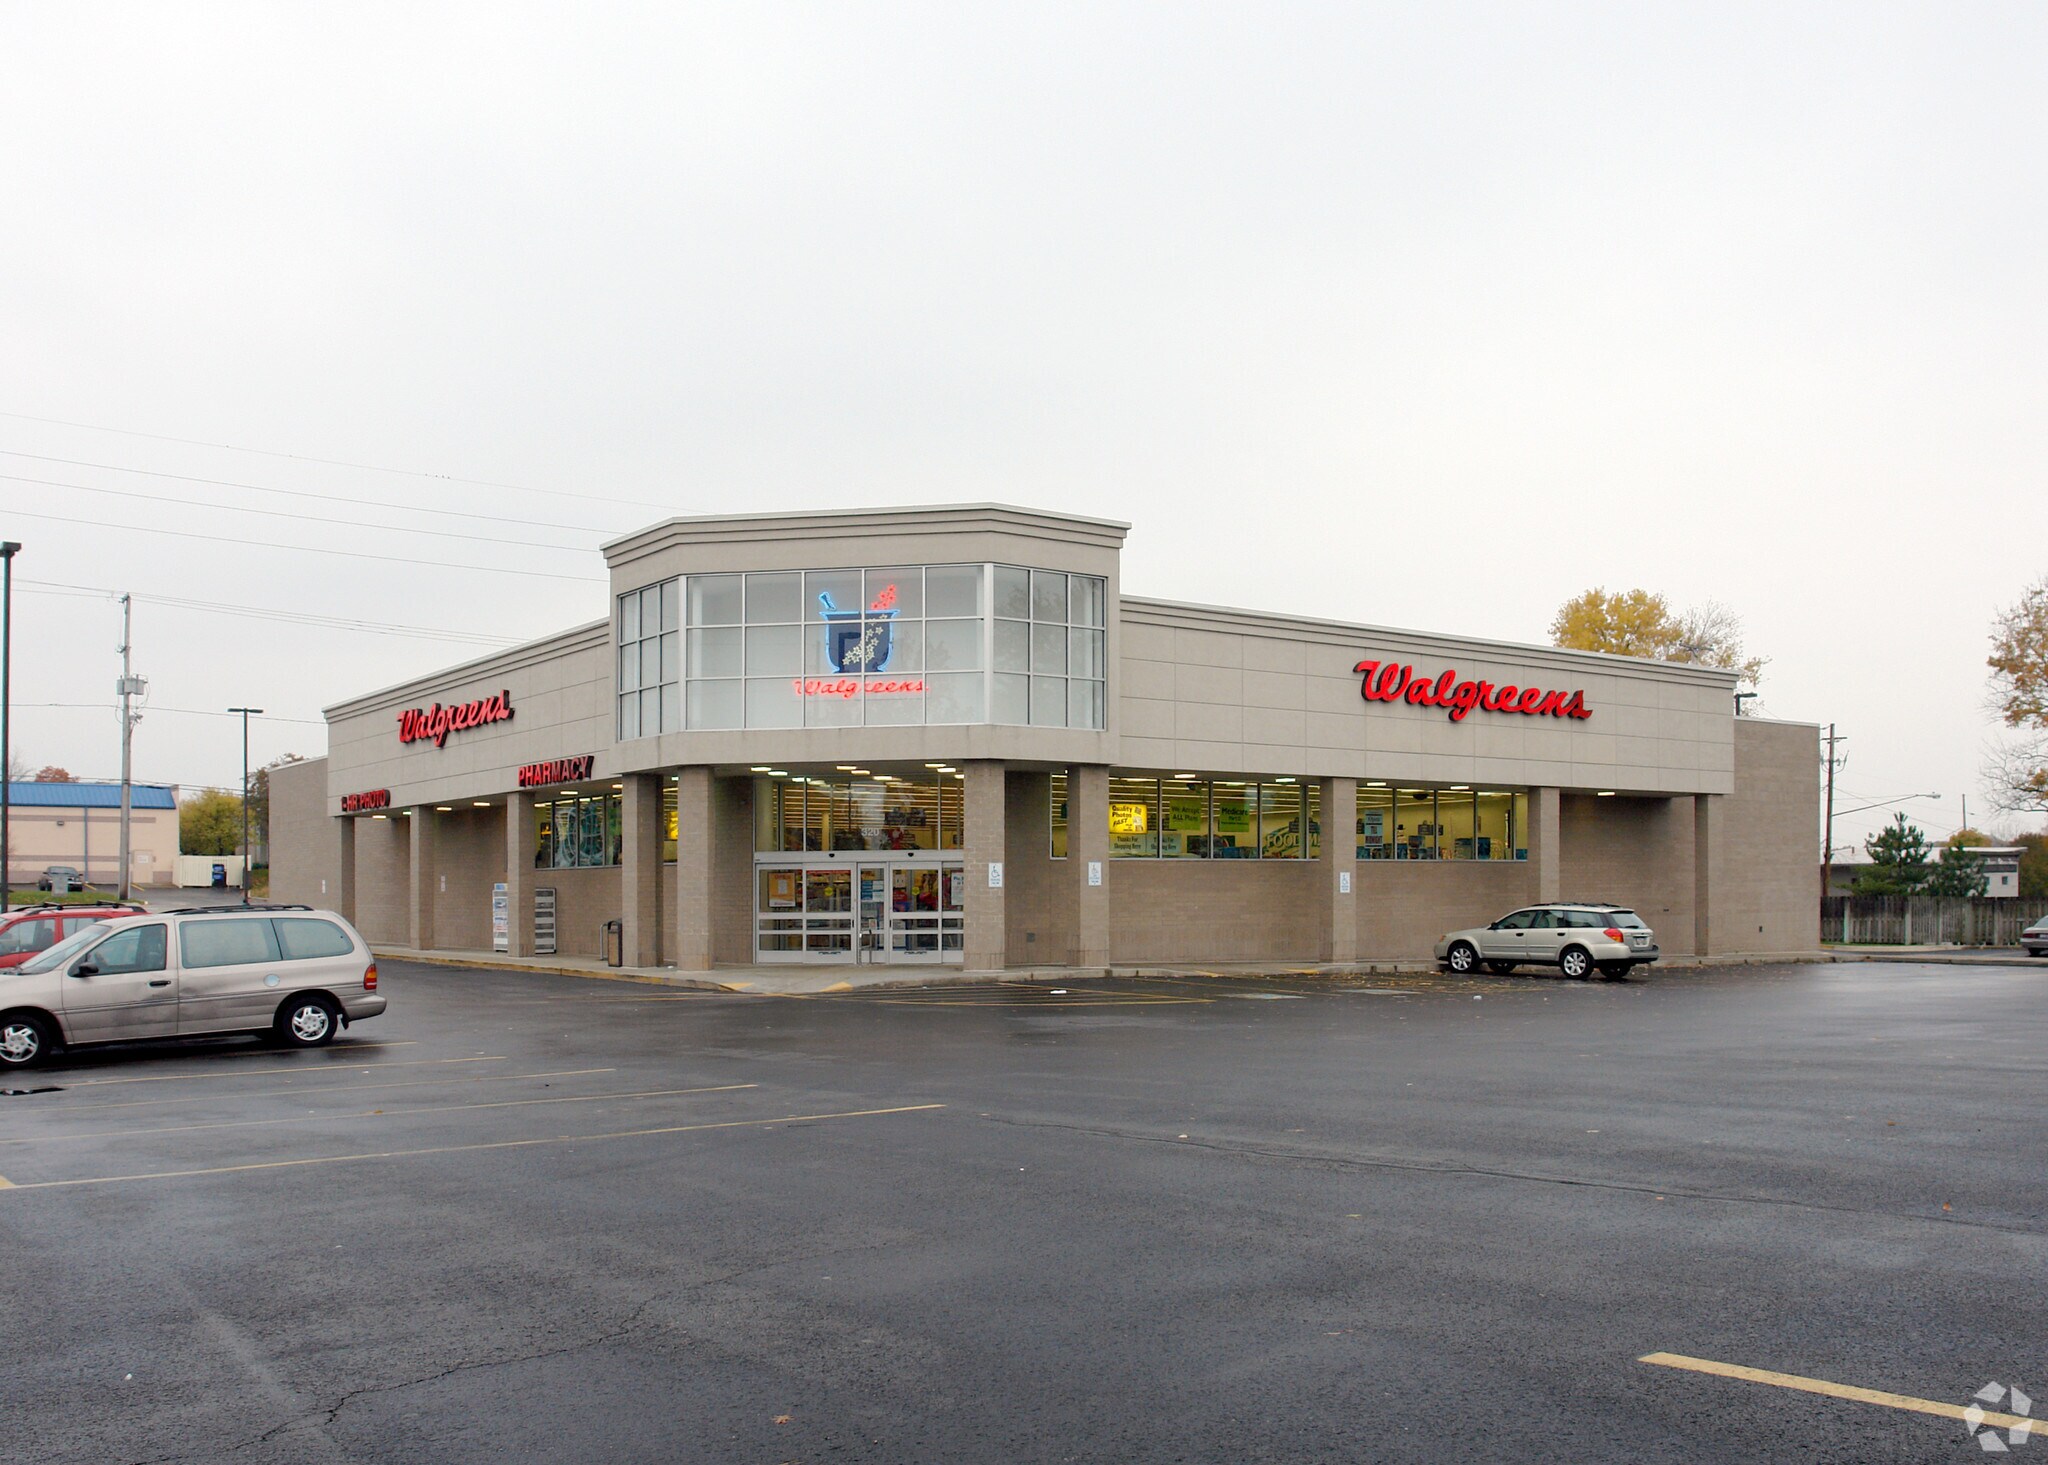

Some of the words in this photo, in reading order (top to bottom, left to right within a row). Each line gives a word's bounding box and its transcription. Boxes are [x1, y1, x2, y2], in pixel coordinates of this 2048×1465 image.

[792, 679, 929, 699] Walgreens
[1354, 660, 1593, 721] Walgreens
[397, 690, 515, 747] Walgreens
[518, 755, 594, 787] PHARMACY
[360, 789, 391, 809] PHOTO
[1112, 805, 1132, 813] Quality
[1221, 807, 1248, 815] Medicare
[861, 827, 880, 837] 320
